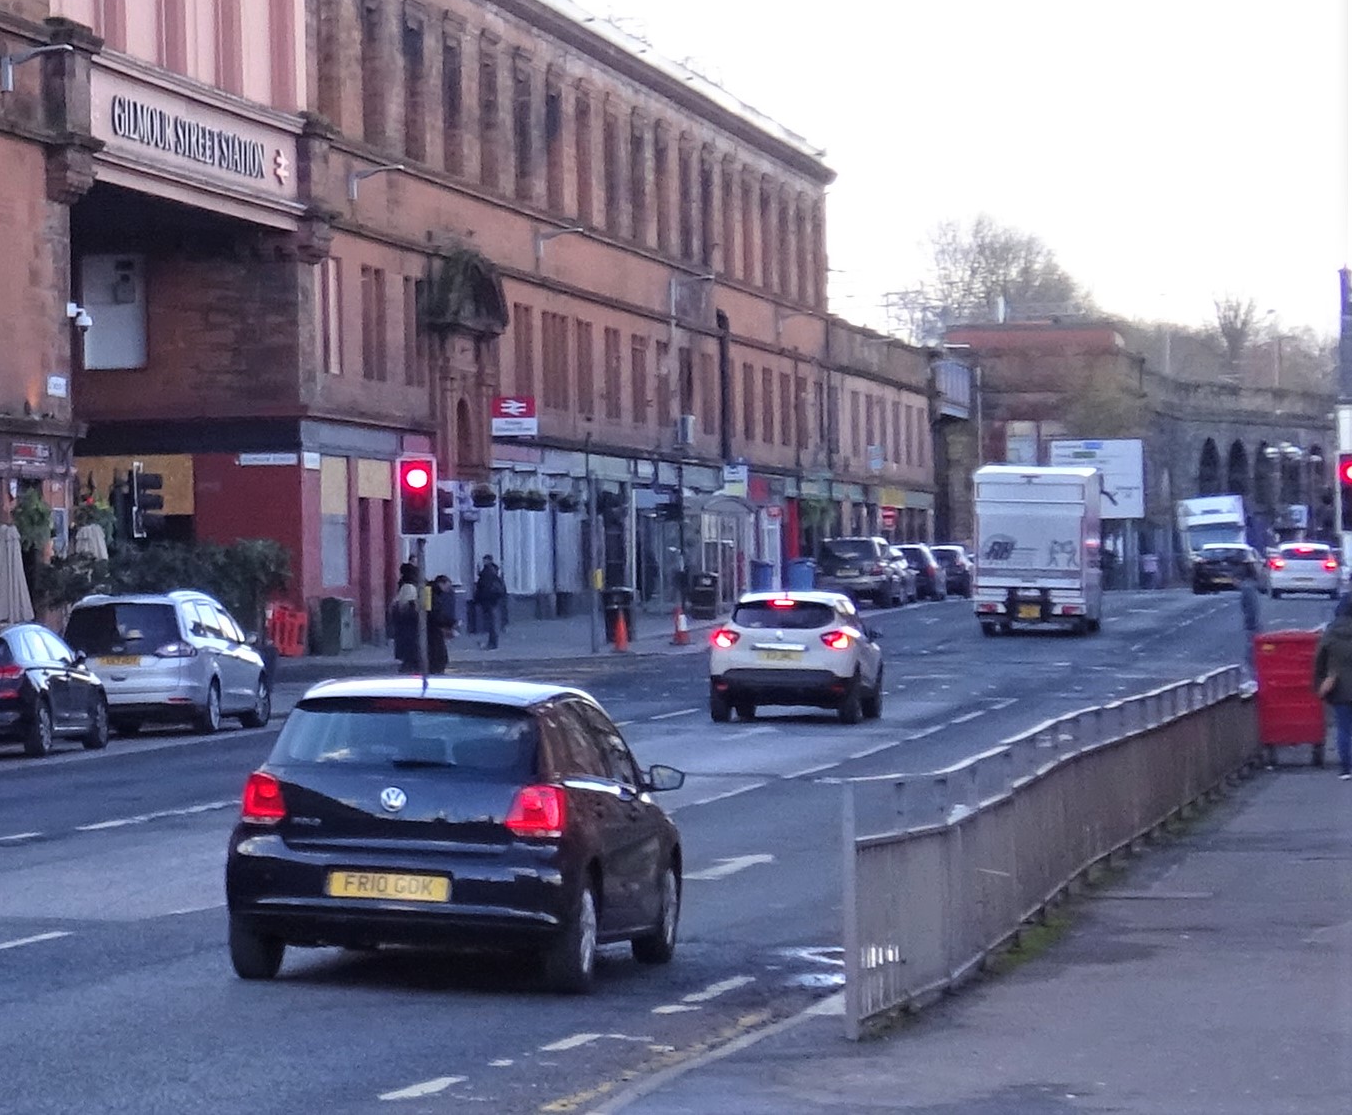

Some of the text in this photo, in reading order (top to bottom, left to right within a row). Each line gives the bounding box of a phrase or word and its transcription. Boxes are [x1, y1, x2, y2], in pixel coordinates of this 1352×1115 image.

[111, 94, 265, 179] GILMOUR STREET STATION
